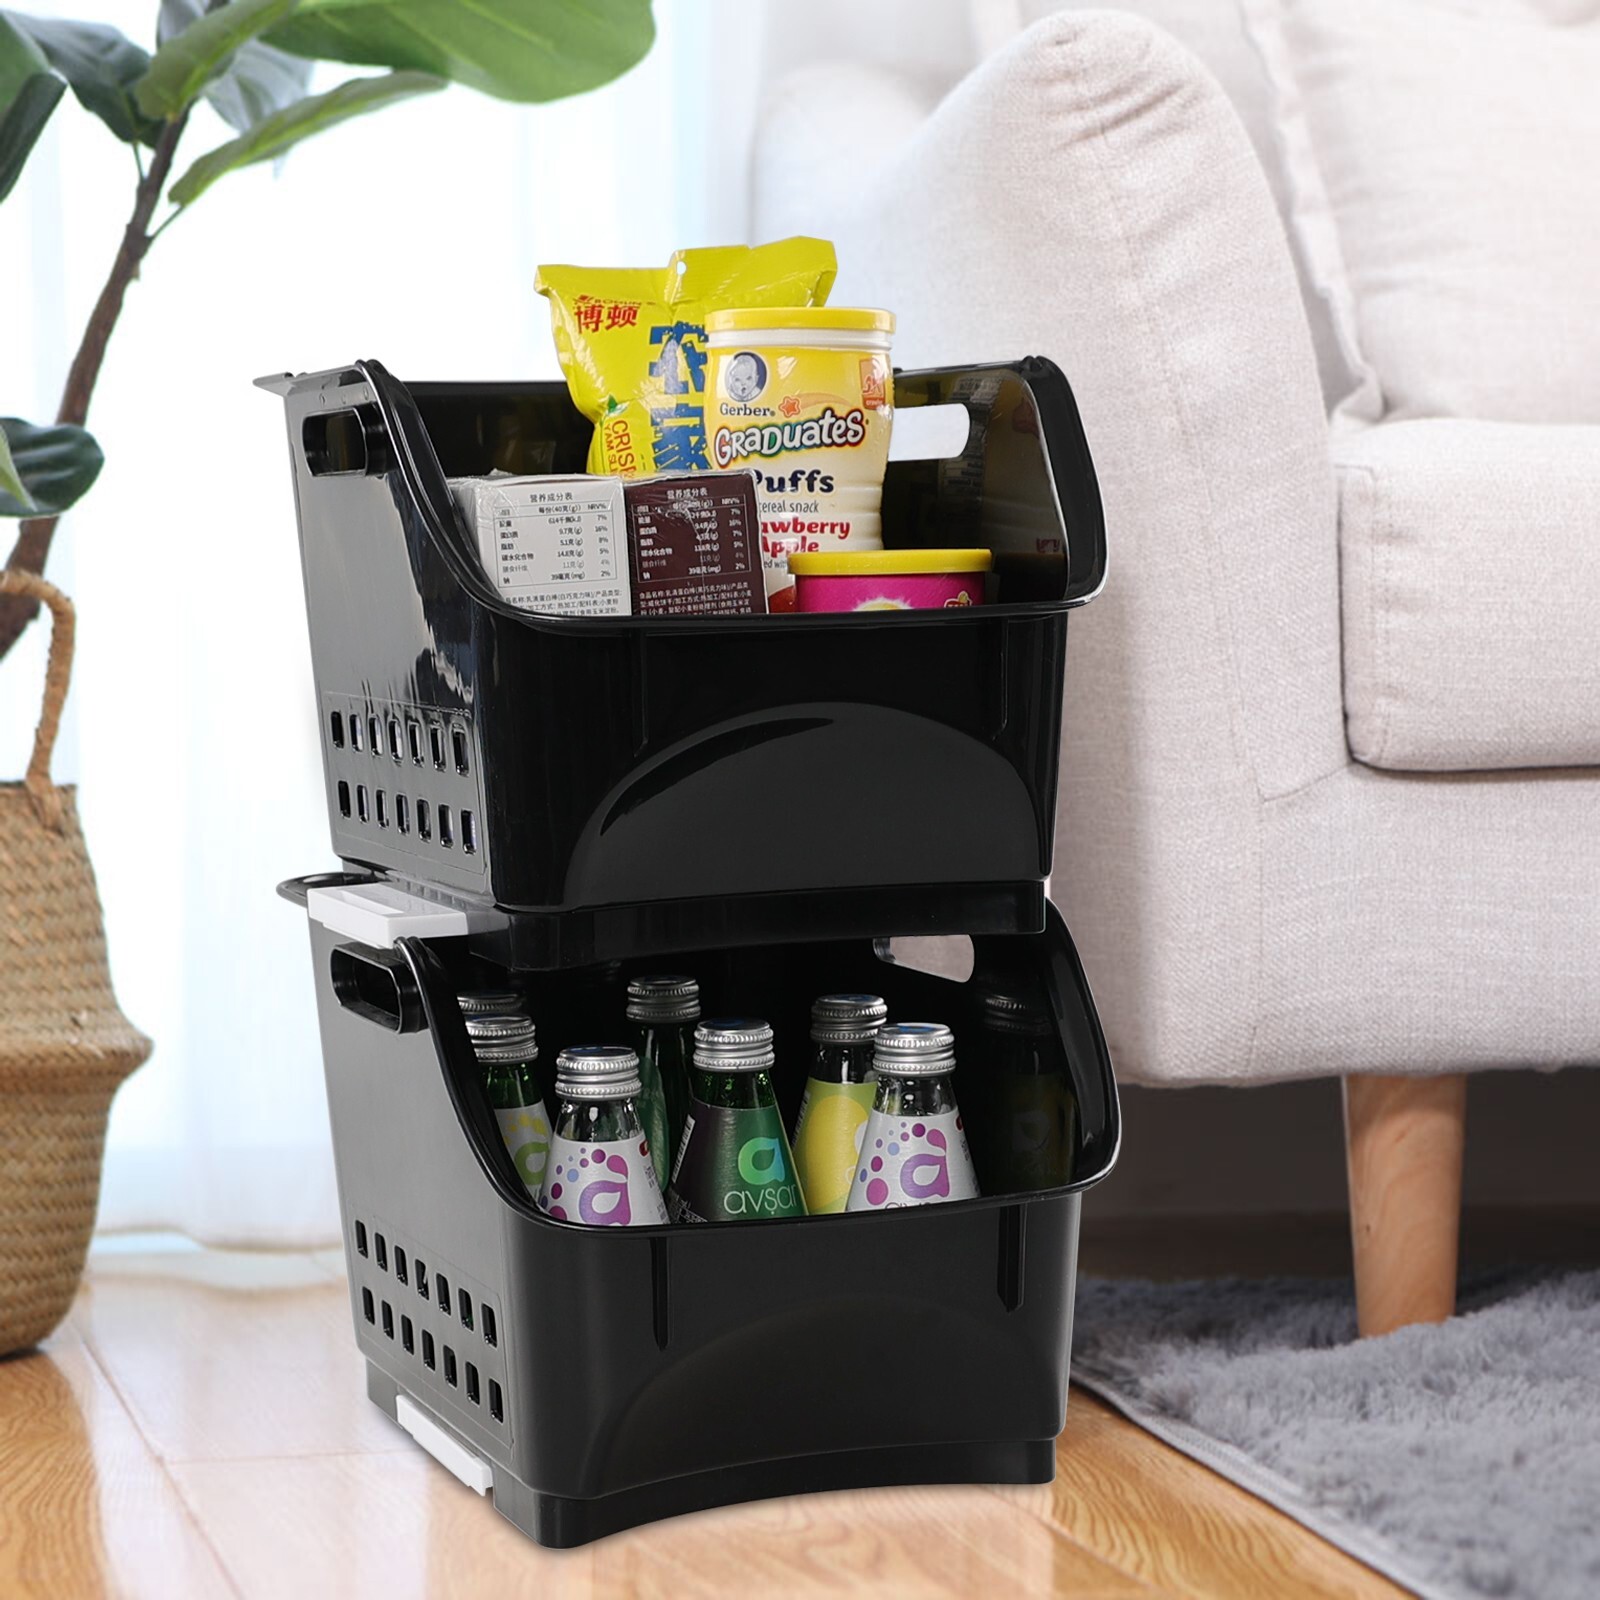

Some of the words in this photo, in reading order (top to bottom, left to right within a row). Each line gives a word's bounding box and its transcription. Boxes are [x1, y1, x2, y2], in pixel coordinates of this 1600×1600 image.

[574, 303, 641, 334] 博顿
[720, 403, 771, 416] Gerber
[790, 500, 819, 513] snack
